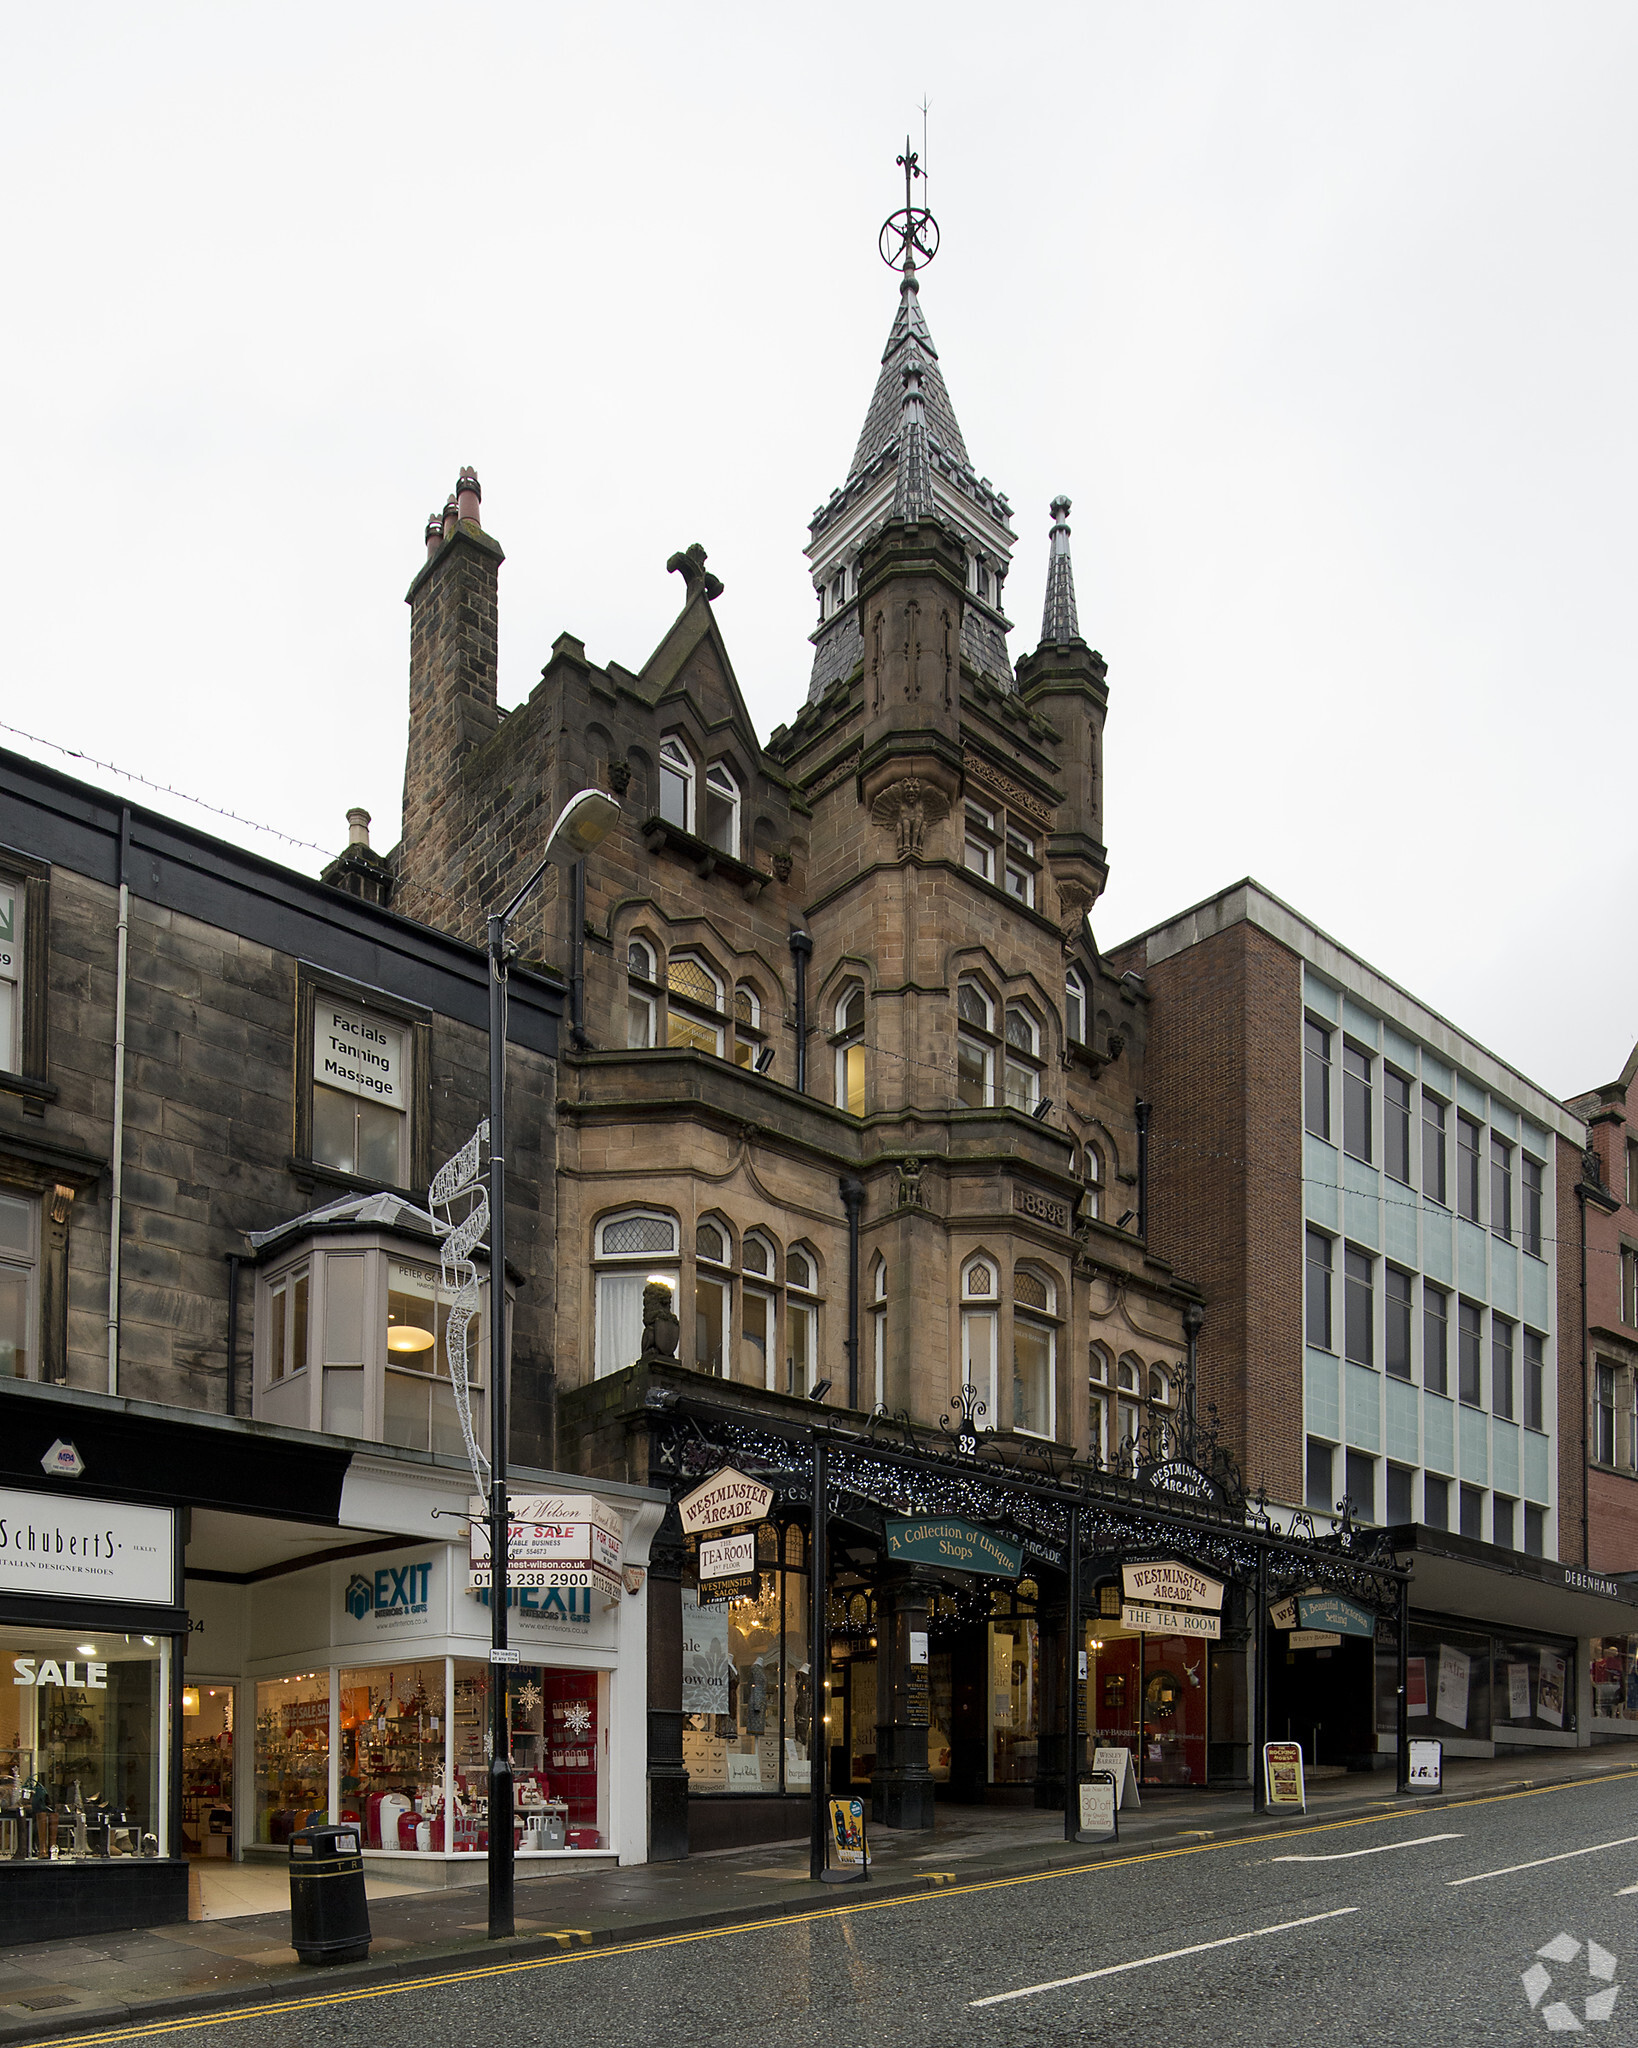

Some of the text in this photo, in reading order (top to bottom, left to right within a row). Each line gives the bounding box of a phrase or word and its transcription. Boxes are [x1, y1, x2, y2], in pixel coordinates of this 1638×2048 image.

[333, 1014, 387, 1045] Facials
[329, 1036, 390, 1072] Tanning
[324, 1058, 393, 1094] Massage
[399, 1266, 422, 1280] PETER
[959, 1434, 976, 1456] 32
[1149, 1463, 1214, 1500] WESTMINSTER
[1162, 1478, 1201, 1498] ARCADE
[533, 1500, 581, 1518] Wilson
[686, 1483, 768, 1521] WESTMINSTER
[702, 1501, 752, 1525] ARCADE
[507, 1527, 574, 1538] OR SALE
[596, 1530, 606, 1546] FOR
[608, 1538, 620, 1554] SALE
[702, 1543, 753, 1567] TEA ROOM
[890, 1536, 902, 1551] A
[904, 1525, 962, 1544] Collection
[966, 1532, 979, 1544] of
[980, 1536, 1015, 1572] Unique
[939, 1540, 973, 1560] Shops
[38, 1562, 83, 1573] DESIGNER
[85, 1566, 114, 1576] SHOES
[723, 1561, 741, 1570] FLOOR
[375, 1562, 432, 1609] EXIT
[474, 1574, 588, 1586] 013 238 2900
[701, 1577, 753, 1592] WESTMINSTER
[1133, 1568, 1207, 1598] WESTMINSTER
[1565, 1570, 1618, 1596] DEBENHAMS
[714, 1588, 739, 1598] SALON
[1153, 1584, 1192, 1601] ARCADE
[375, 1604, 428, 1618] INTERIORS & GIFTS
[520, 1608, 591, 1623] INTERIORS & GIFTS
[1301, 1608, 1308, 1619] A
[1308, 1600, 1339, 1614] Beautiful
[519, 1622, 589, 1634] www.exitinteriors.co.uk
[1128, 1609, 1216, 1632] THE TEA ROOM
[682, 1639, 701, 1652] ale
[13, 1658, 107, 1689] SALE
[707, 1677, 723, 1686] on
[299, 1704, 317, 1718] SALE
[318, 1702, 330, 1716] SAL
[1100, 1799, 1111, 1811] off
